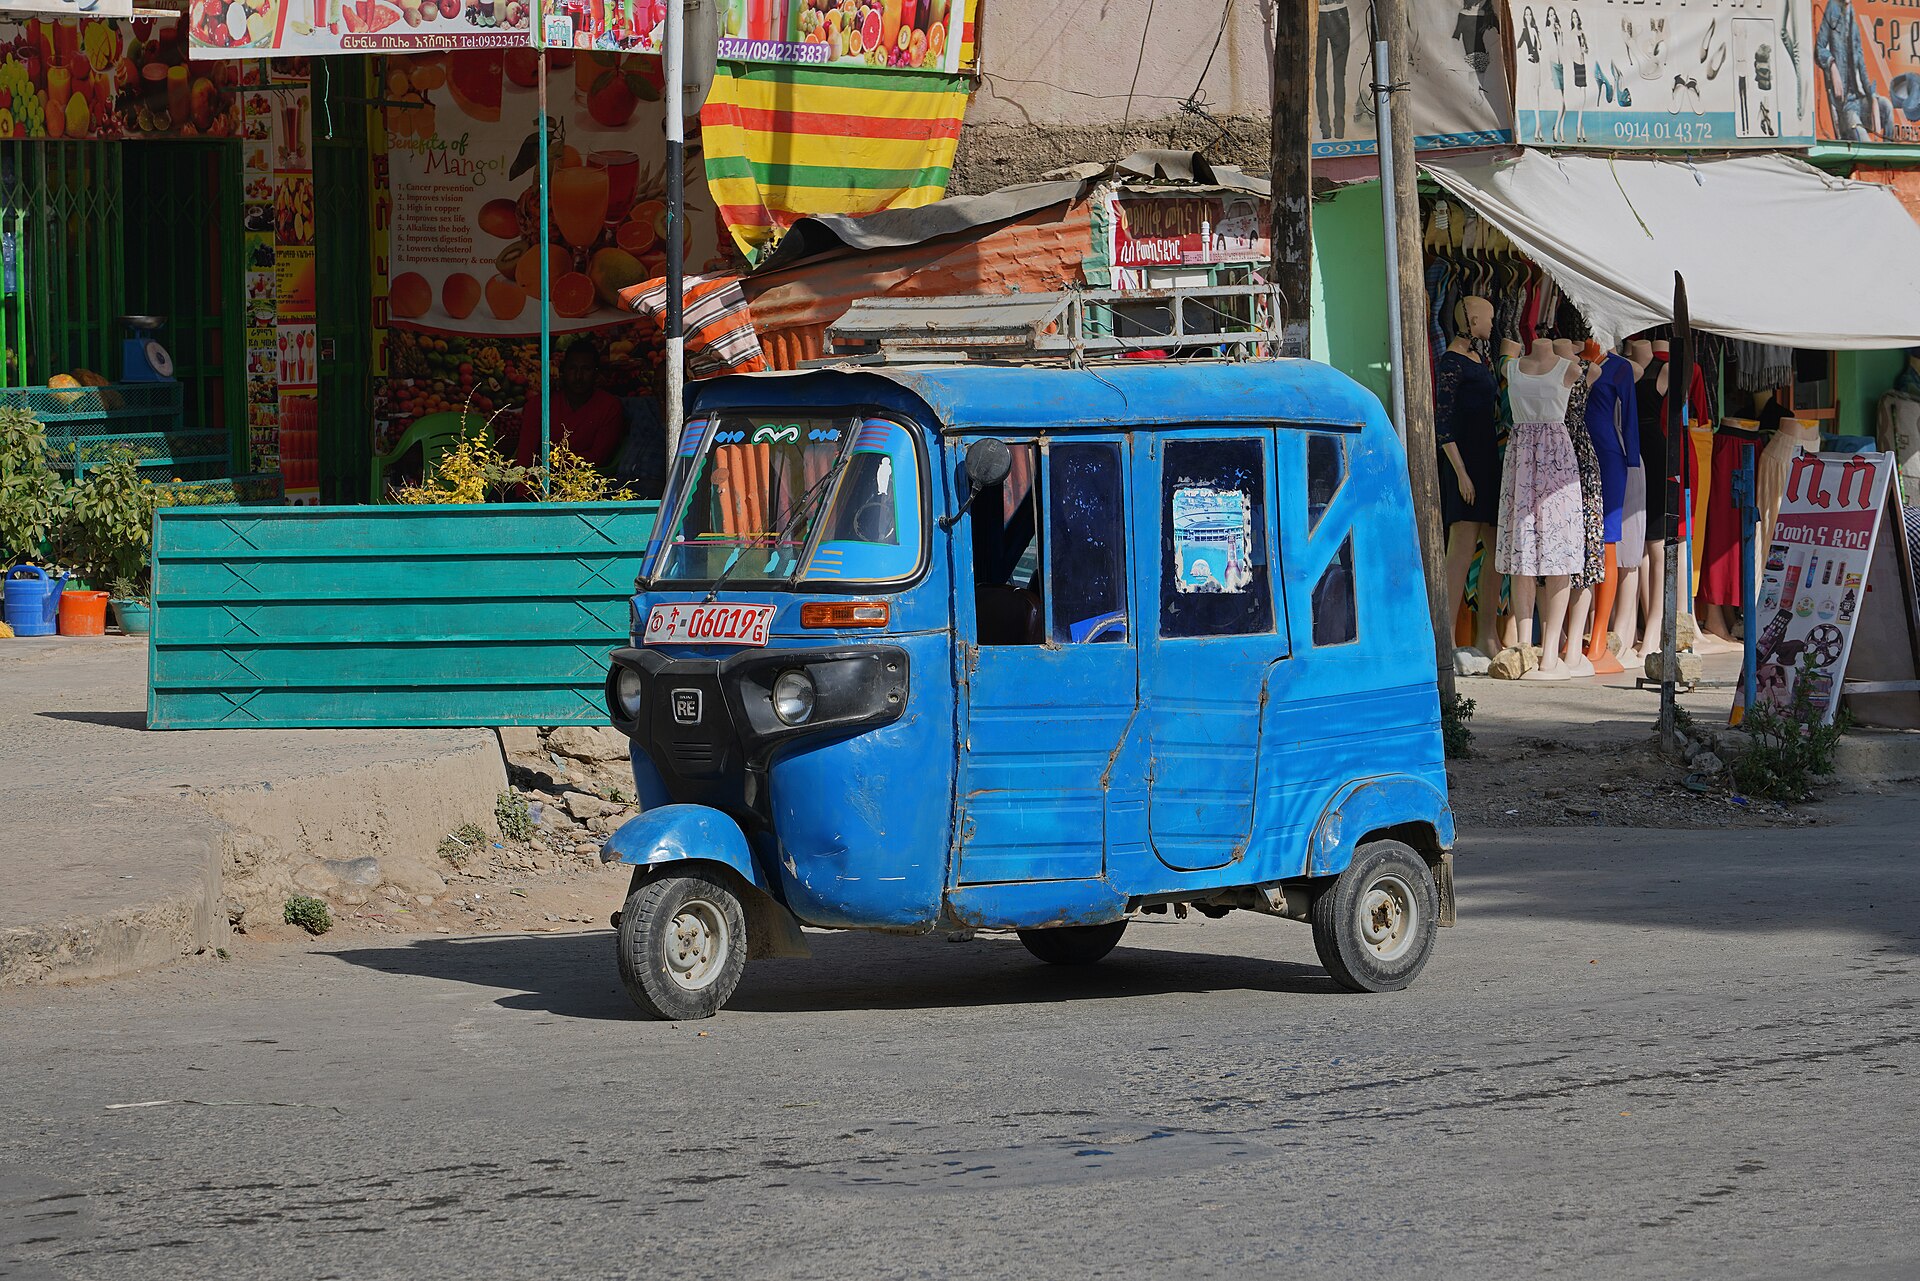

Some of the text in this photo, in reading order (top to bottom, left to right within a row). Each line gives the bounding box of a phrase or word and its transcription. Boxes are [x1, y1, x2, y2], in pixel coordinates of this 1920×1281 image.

[1614, 121, 1713, 143] 0914 01 43 72
[387, 132, 468, 156] Benefits of
[424, 149, 505, 186] Mango!
[406, 183, 432, 192] Cancer
[434, 184, 474, 194] prevention
[406, 193, 439, 203] Improves
[441, 194, 463, 202] vision
[406, 204, 424, 213] High
[425, 204, 432, 212] in
[434, 206, 460, 215] copper
[406, 214, 439, 223] Improves
[453, 214, 465, 222] life
[406, 223, 437, 232] Alkalizes
[438, 224, 450, 232] the
[451, 224, 471, 234] body
[406, 234, 439, 243] Improves
[439, 235, 473, 245] digestion
[406, 244, 432, 252] Lowers
[433, 245, 472, 253] cholesterol
[406, 255, 439, 264] Improves
[440, 257, 468, 265] memory
[471, 256, 477, 264] &
[688, 608, 757, 639] 06019
[677, 700, 696, 716] RE
